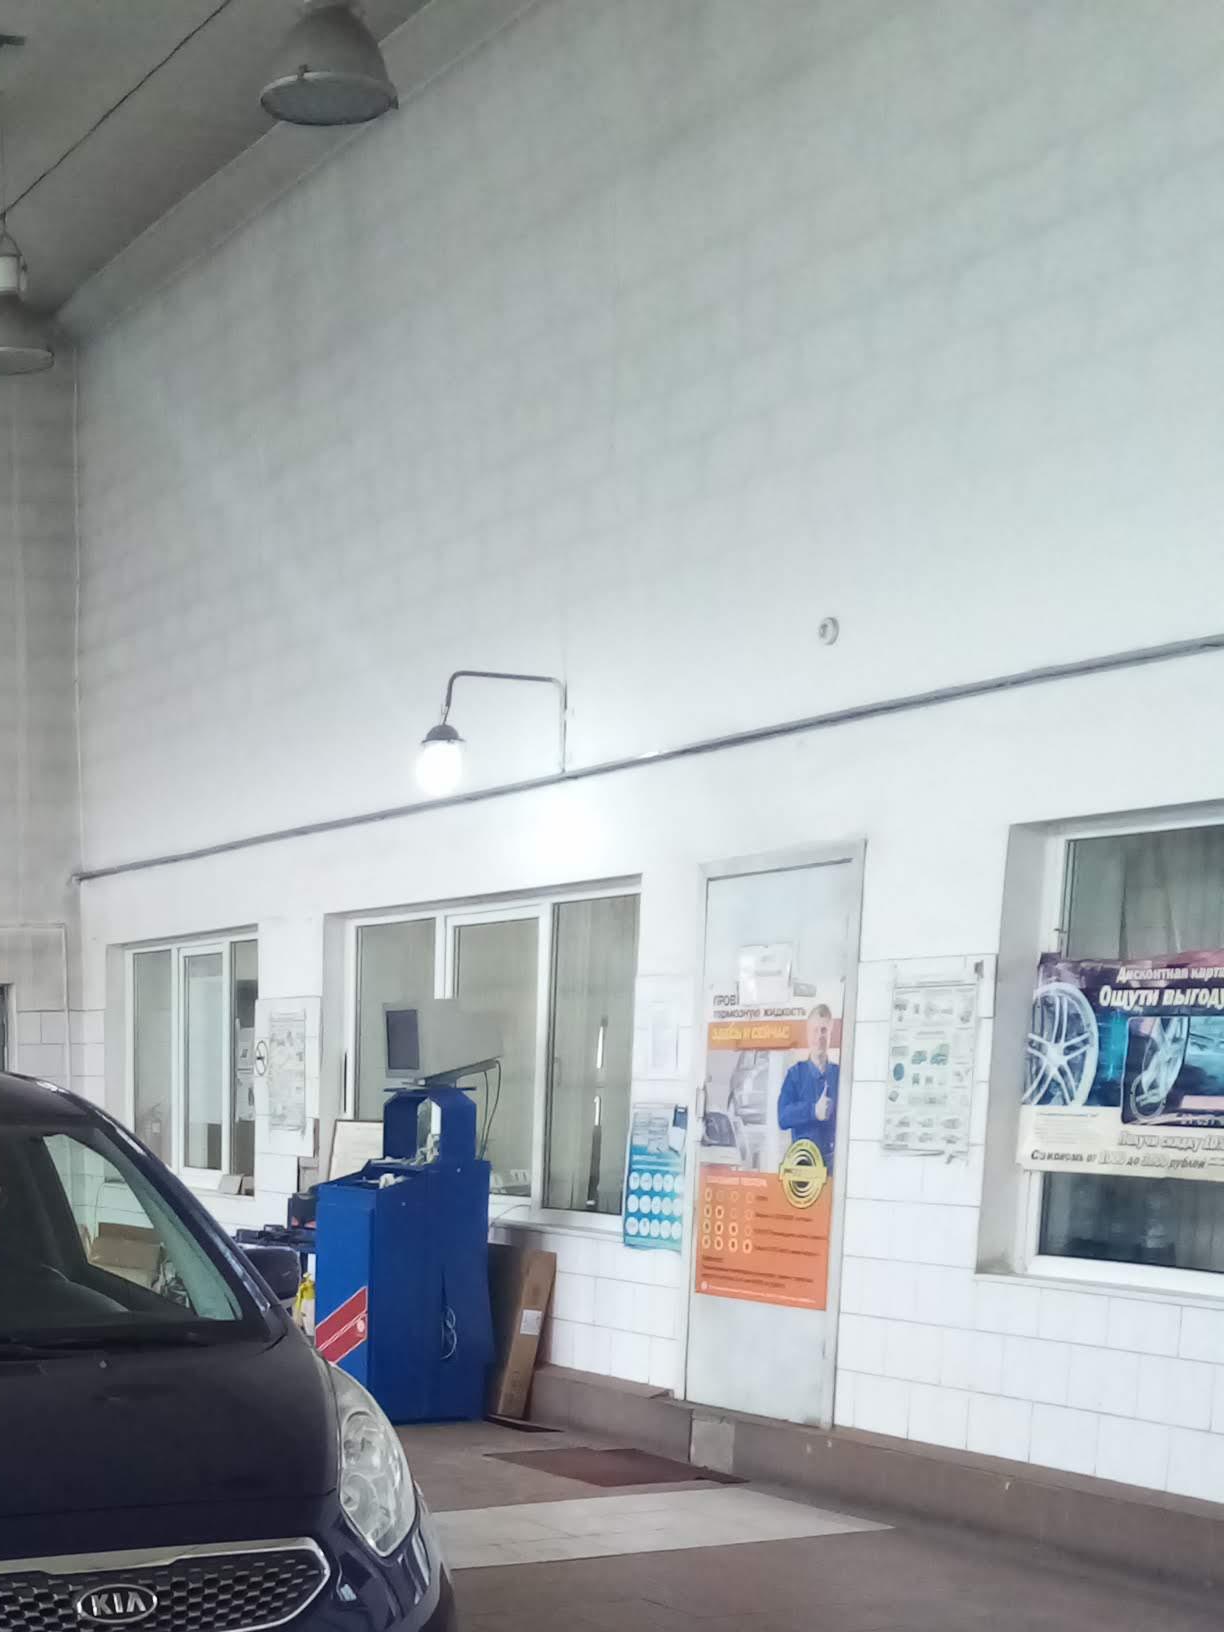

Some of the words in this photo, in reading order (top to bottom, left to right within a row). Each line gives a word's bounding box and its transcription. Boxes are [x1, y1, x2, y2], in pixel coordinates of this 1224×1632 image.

[1116, 967, 1188, 983] Дисконтная
[1099, 985, 1160, 1011] Ощути
[91, 1592, 147, 1616] KIA
